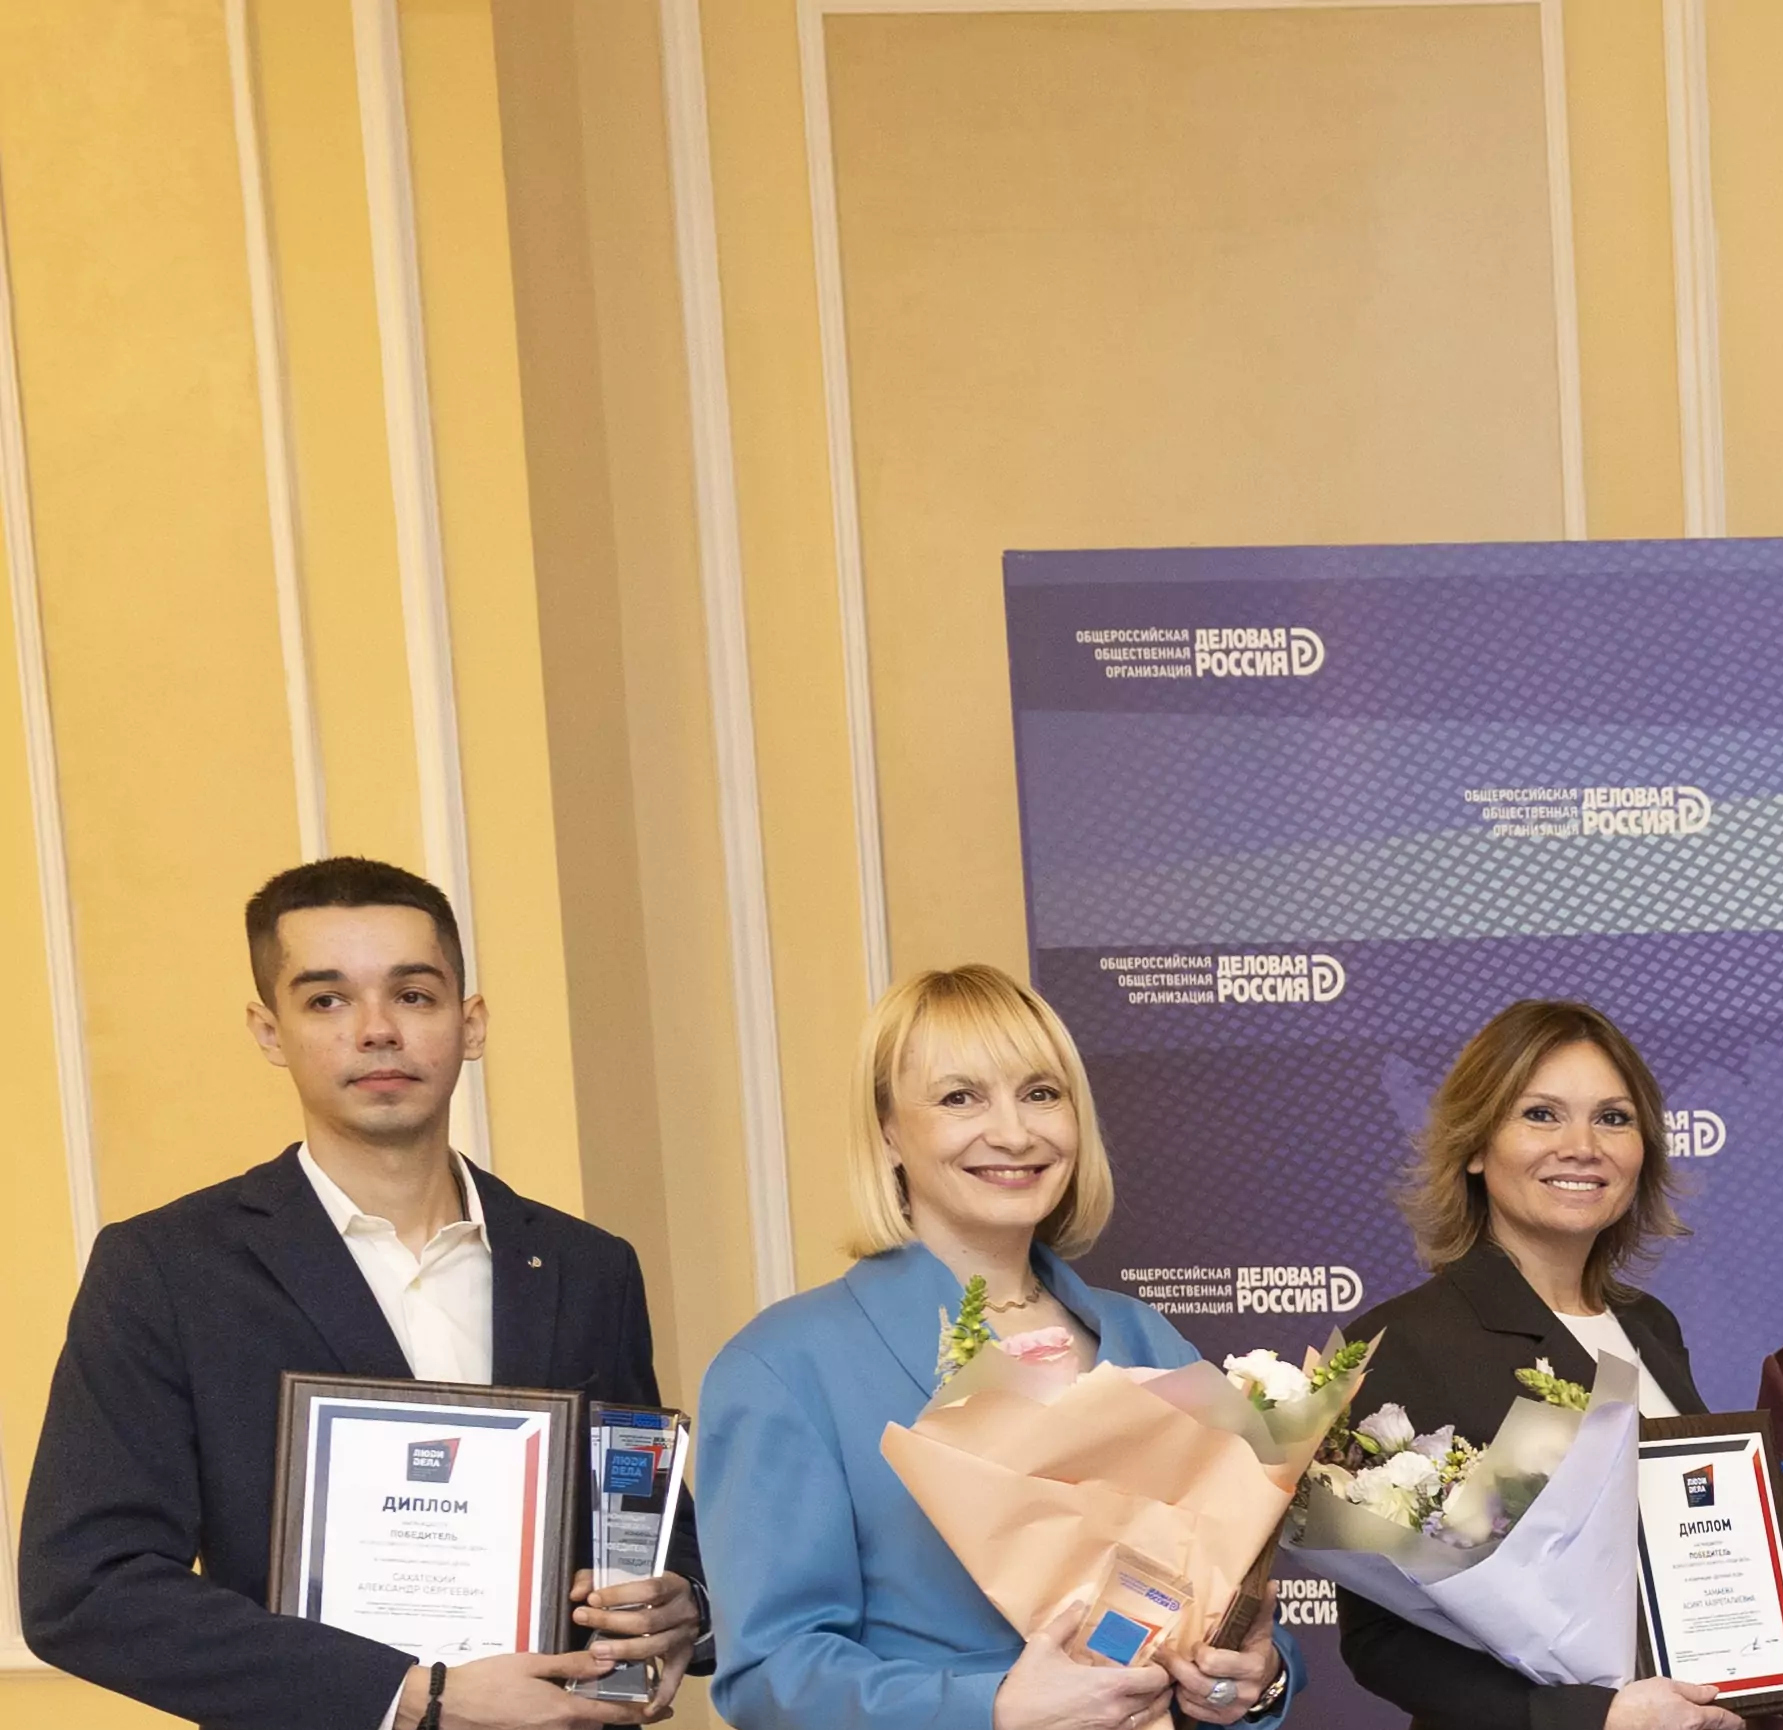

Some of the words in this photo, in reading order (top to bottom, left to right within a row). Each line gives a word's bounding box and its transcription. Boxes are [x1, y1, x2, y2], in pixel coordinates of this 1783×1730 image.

[1076, 628, 1189, 645] ОБЩЕРОССИЙСКАЯ
[1195, 628, 1286, 652] ДЕЛОВАЯ
[1095, 646, 1191, 661] ОБЩЕСТВЕННАЯ
[1106, 664, 1191, 678] ОРГАНИЗАЦИЯ
[1196, 651, 1288, 676] РОССИЯ
[1465, 787, 1577, 803] ОБЩЕРОССИЙСКАЯ
[1582, 786, 1674, 810] ДЕЛОВАЯ
[1482, 804, 1578, 820] ОБЩЕСТВЕННАЯ
[1493, 822, 1579, 837] ОРГАНИЗАЦИЯ
[1583, 810, 1676, 834] РОССИЯ
[1100, 955, 1211, 971] ОБЩЕРОССИЙСКАЯ
[1216, 954, 1307, 979] ДЕЛОВАЯ
[1118, 972, 1212, 988] ОБЩЕСТВЕННАЯ
[1129, 990, 1213, 1004] ОРГАНИЗАЦИЯ
[1217, 978, 1309, 1002] РОССИЯ
[1121, 1266, 1231, 1281] ОБЩЕРОССИЙСКАЯ
[1236, 1266, 1326, 1288] ДЕЛОВАЯ
[1138, 1285, 1232, 1298] ОБЩЕСТВЕННАЯ
[1237, 1288, 1327, 1313] РОССИЯ
[383, 1496, 468, 1514] ДИПЛОМ
[390, 1530, 458, 1541] ПОБЕДИТЕЛЬ
[1679, 1518, 1732, 1537] ДИПЛОМ
[1689, 1549, 1731, 1561] ПОБЕДИТЕЛЬ
